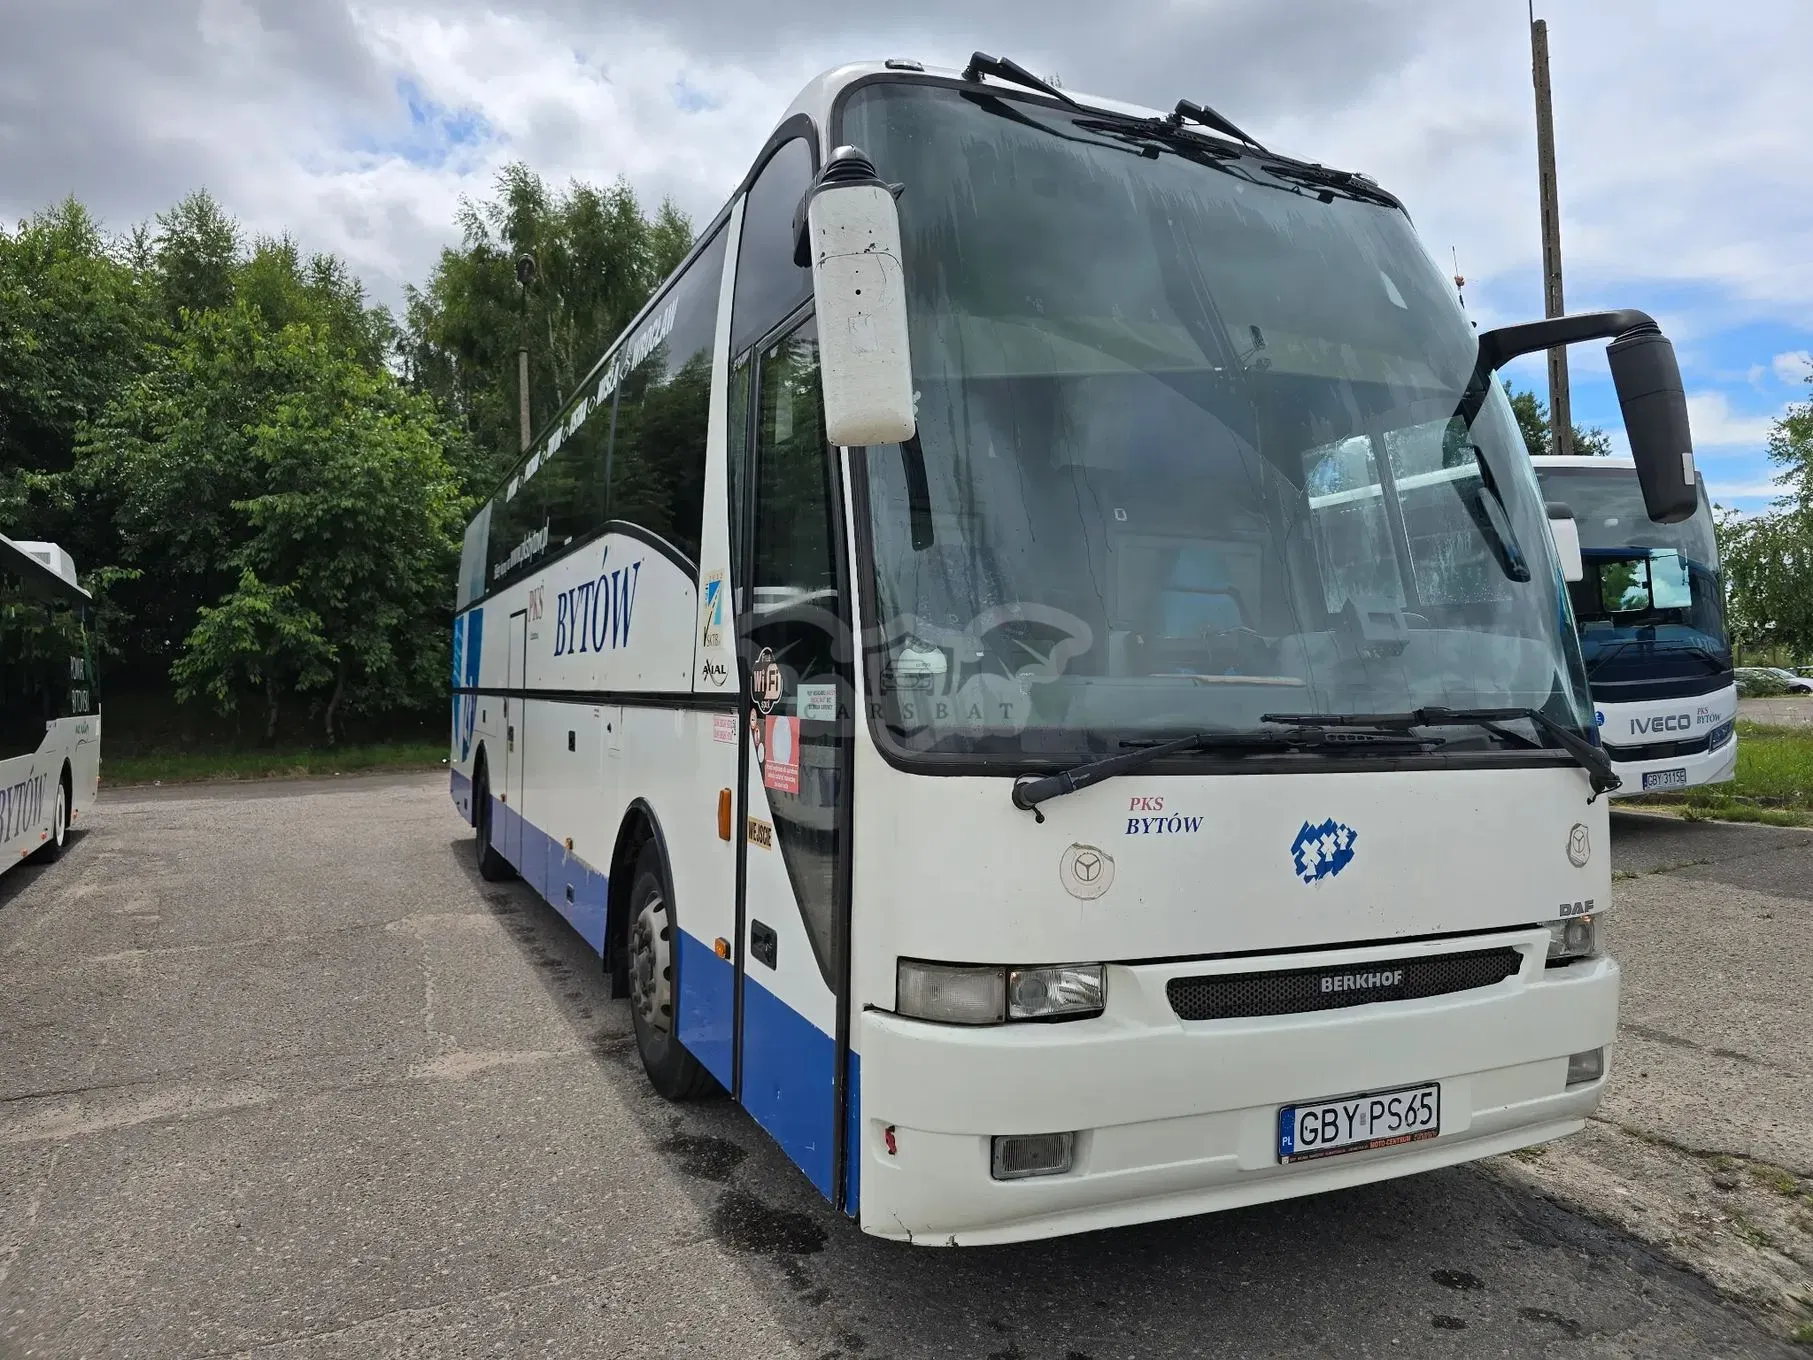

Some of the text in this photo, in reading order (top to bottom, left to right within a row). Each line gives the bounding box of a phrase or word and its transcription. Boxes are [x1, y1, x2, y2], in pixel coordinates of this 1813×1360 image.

[528, 545, 641, 656] PKS BYTÓW
[702, 659, 727, 682] AXIAL
[1630, 714, 1691, 734] IVECO
[1129, 796, 1164, 811] PKS
[1125, 812, 1204, 834] BYTÓW
[1560, 899, 1594, 917] DAF
[1321, 970, 1402, 993] BERKHOF
[1300, 1092, 1433, 1146] GBY PS65
[1282, 1137, 1293, 1147] PL
